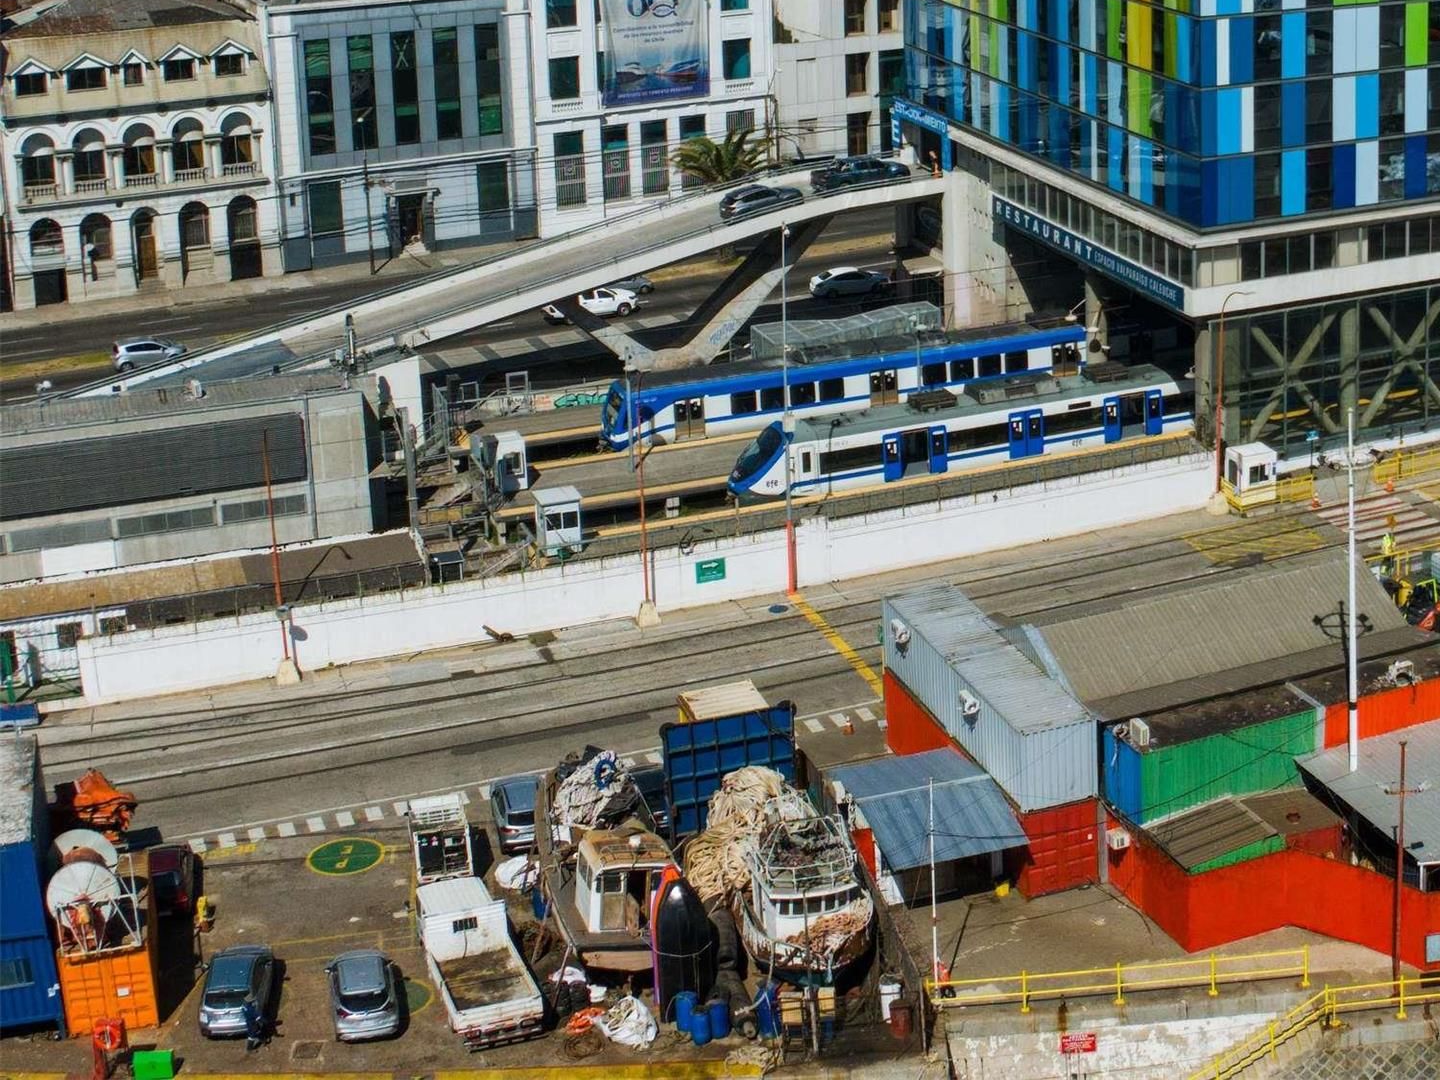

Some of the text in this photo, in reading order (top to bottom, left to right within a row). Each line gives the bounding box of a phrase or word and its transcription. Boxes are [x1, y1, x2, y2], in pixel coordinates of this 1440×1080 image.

[995, 200, 1177, 301] RESTAURANT ESPACIO VALPARAISO CALEUCHE
